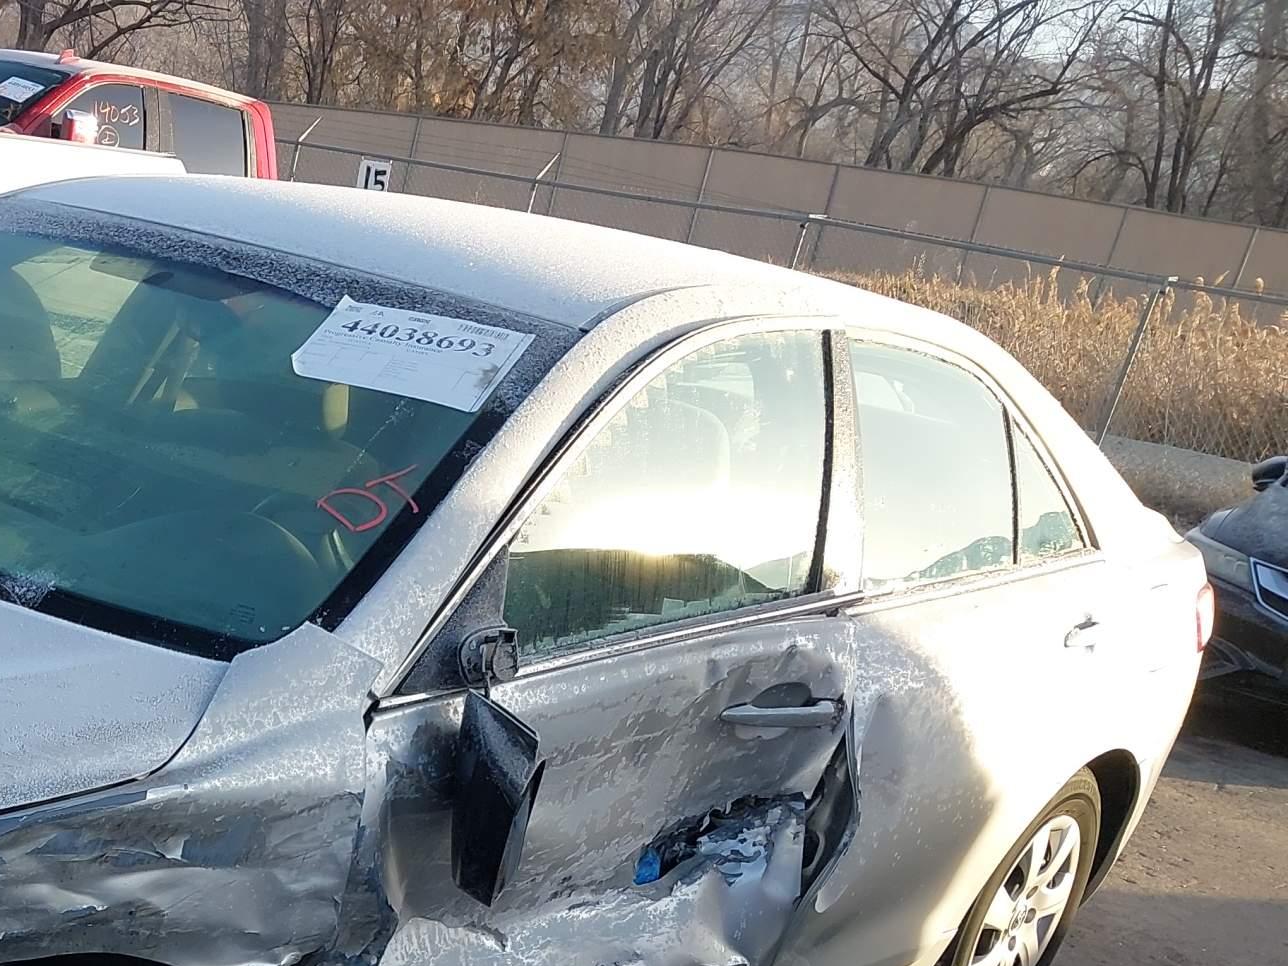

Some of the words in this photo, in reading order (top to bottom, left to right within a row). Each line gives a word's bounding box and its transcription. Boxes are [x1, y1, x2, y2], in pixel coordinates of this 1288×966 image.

[94, 100, 140, 126] 14053
[364, 165, 387, 191] 15
[341, 319, 496, 357] 44038693
